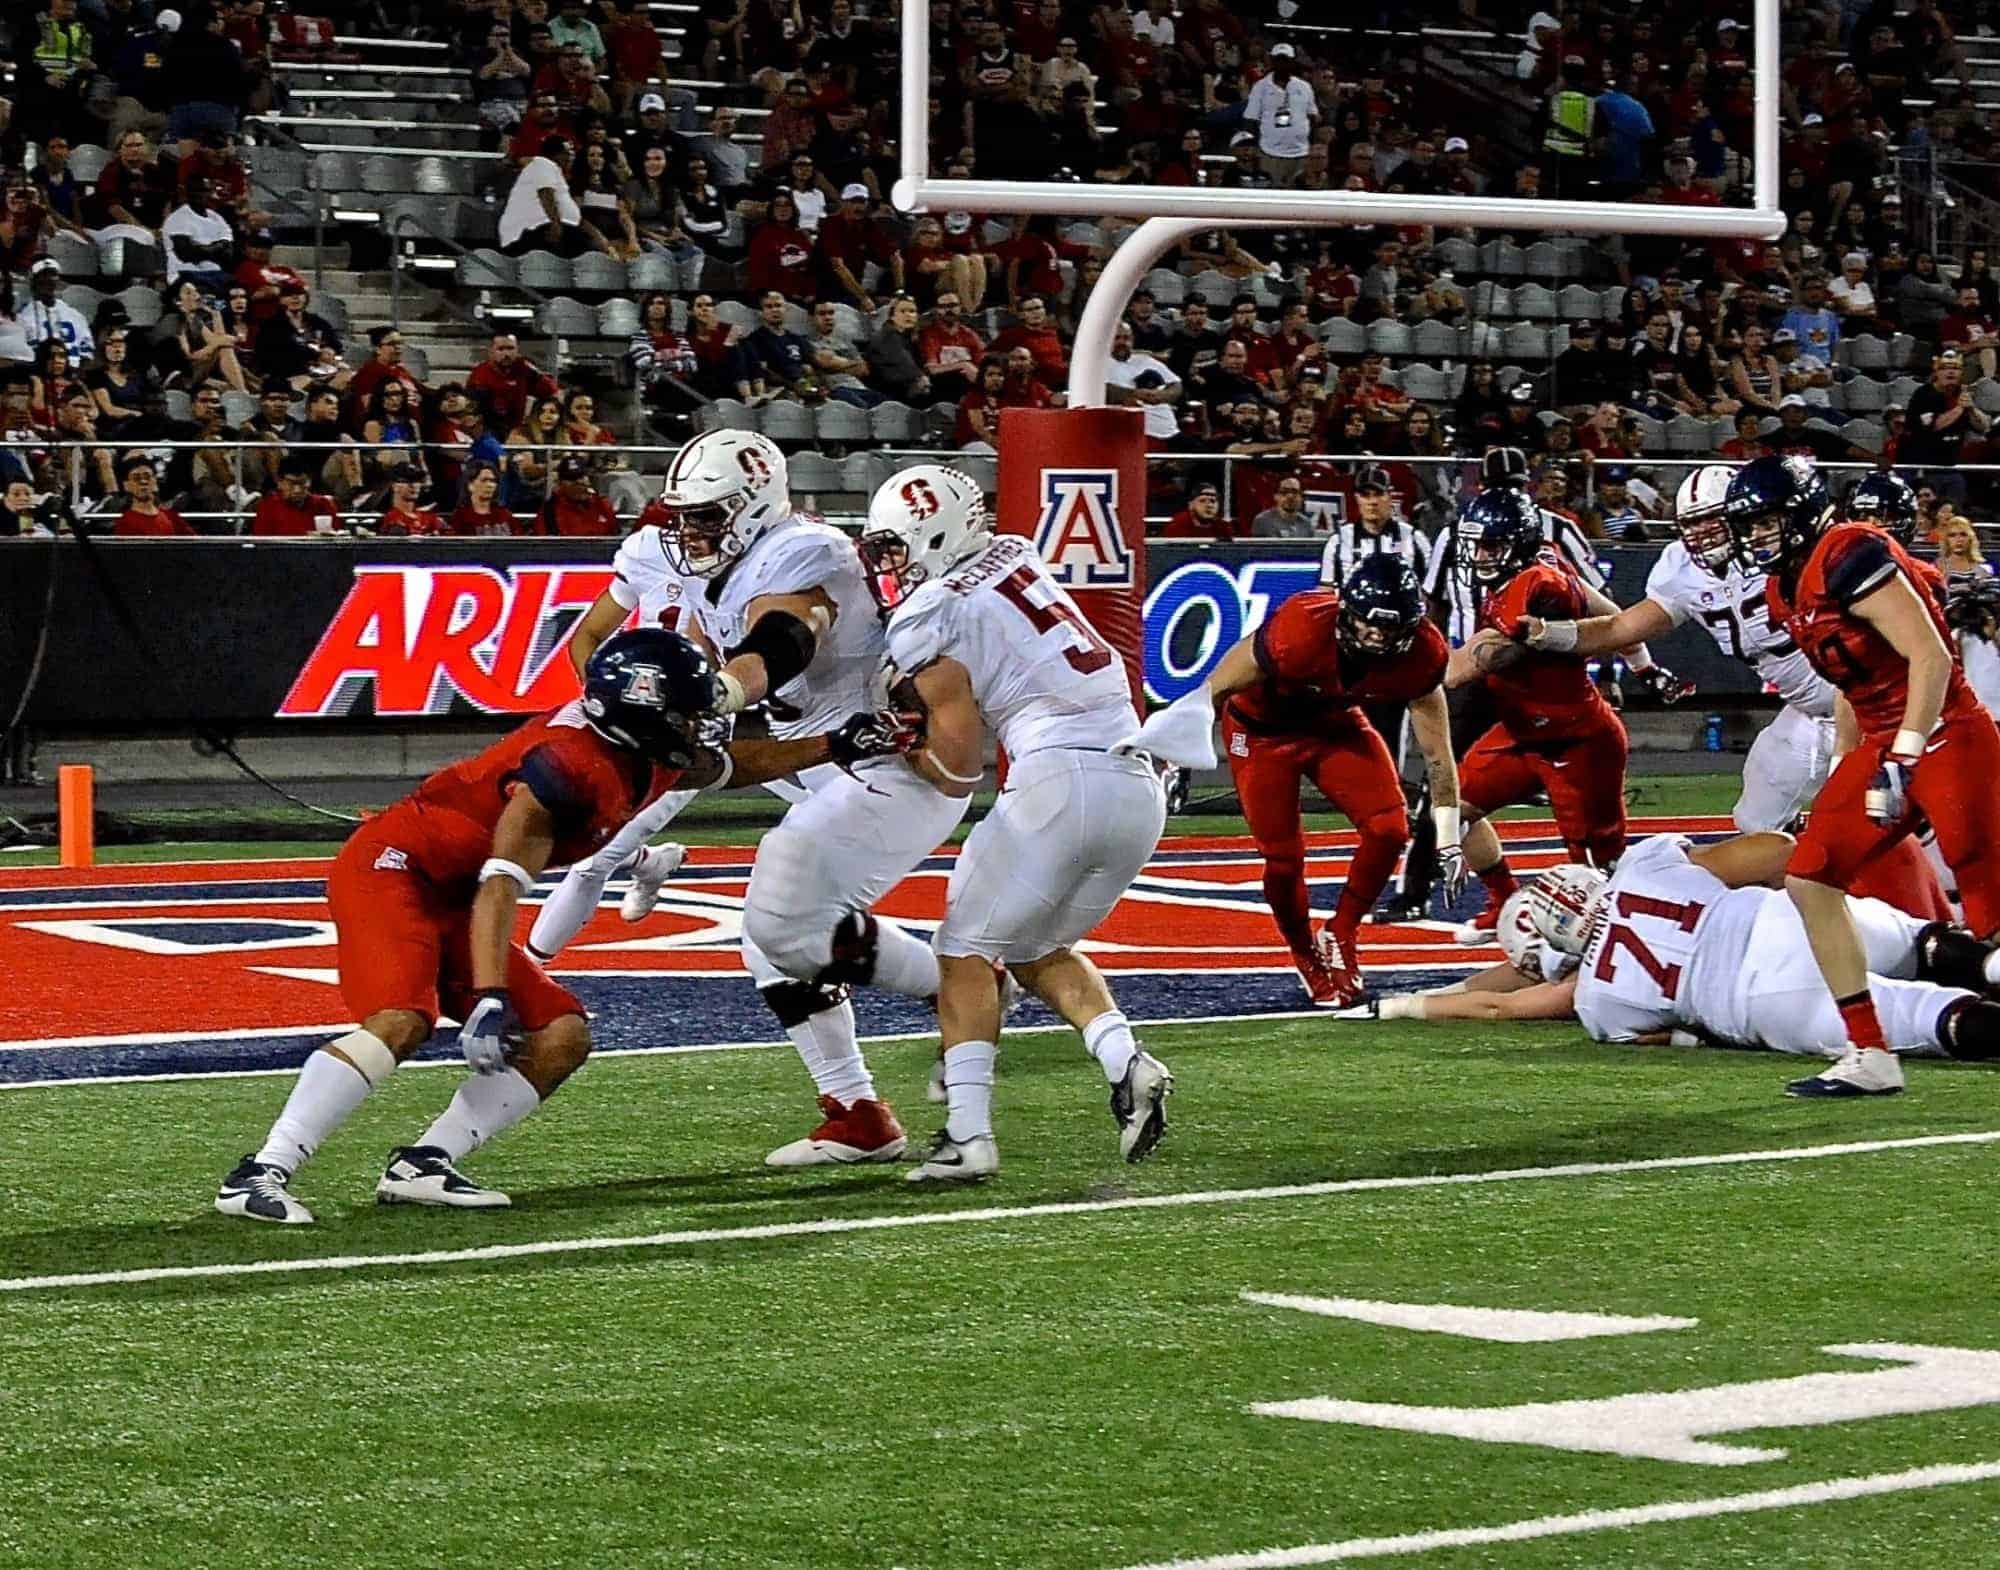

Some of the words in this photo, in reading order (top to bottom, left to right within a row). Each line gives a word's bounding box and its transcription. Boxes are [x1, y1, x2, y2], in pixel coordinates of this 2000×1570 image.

[1032, 468, 1135, 589] A
[992, 563, 1113, 676] 5
[1594, 890, 1706, 1001] 71
